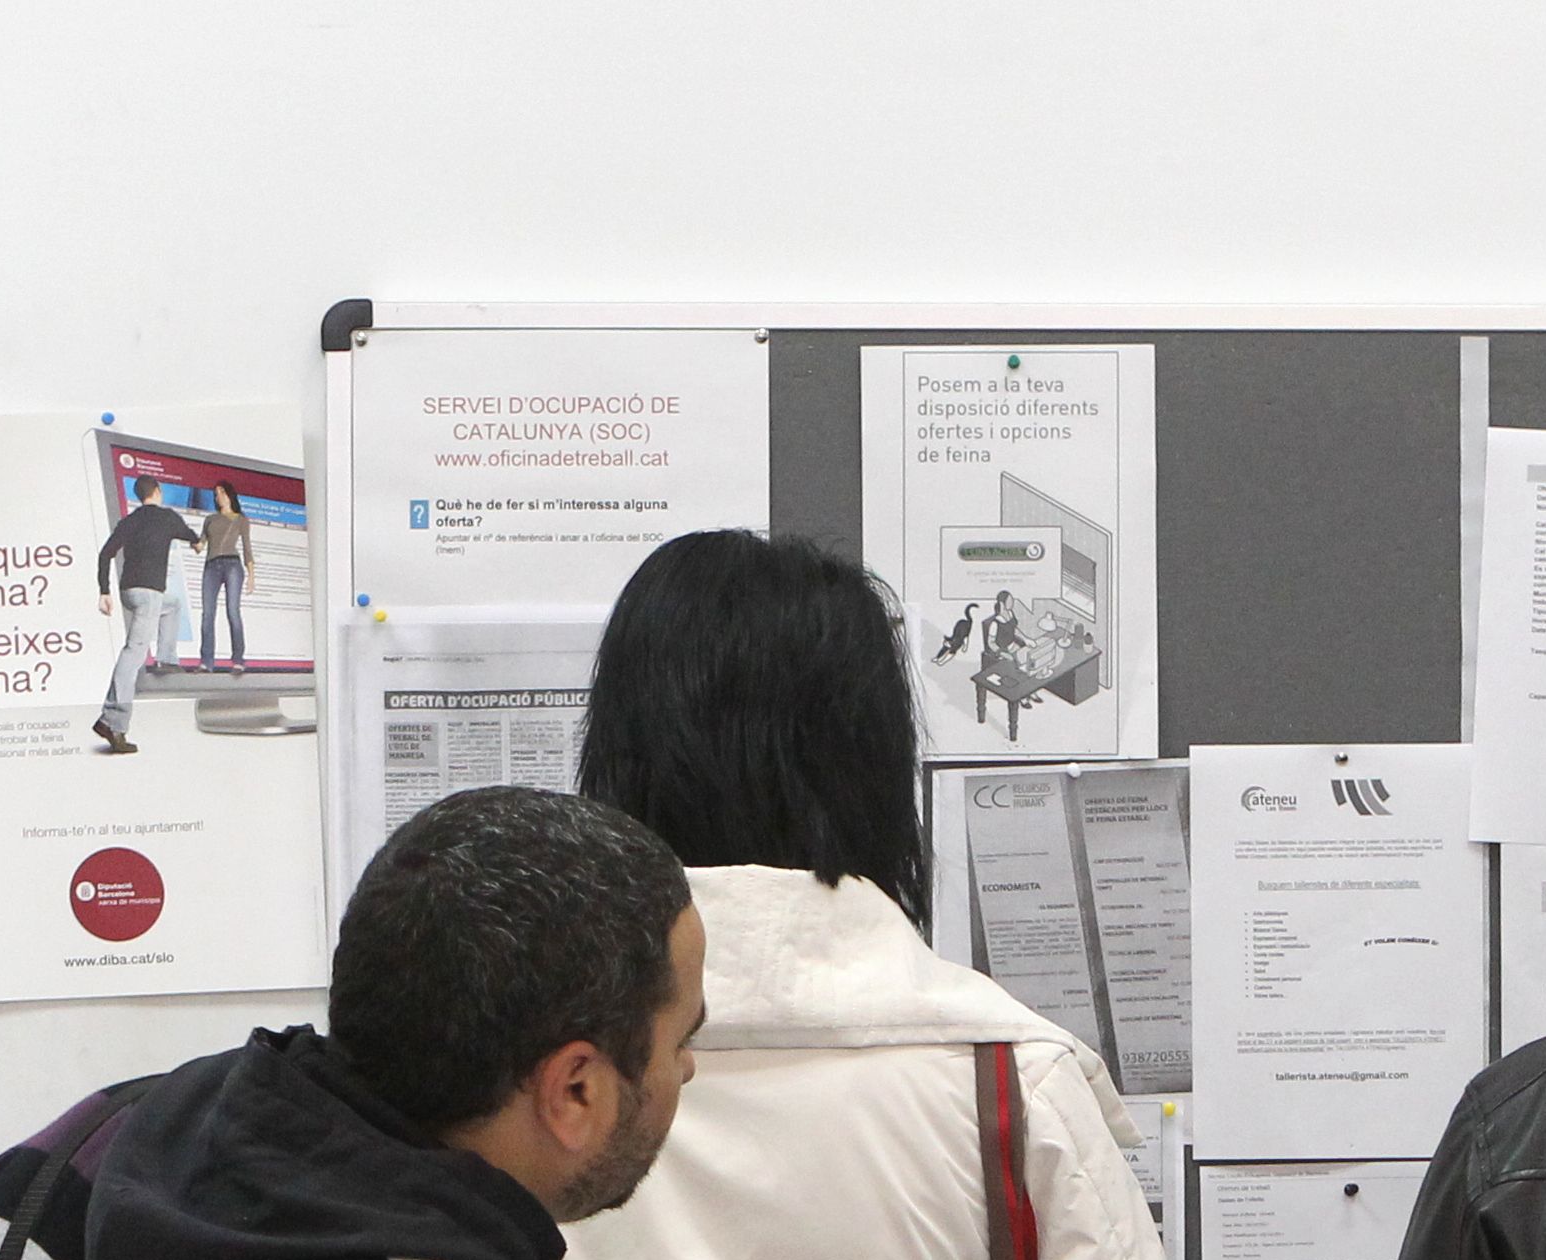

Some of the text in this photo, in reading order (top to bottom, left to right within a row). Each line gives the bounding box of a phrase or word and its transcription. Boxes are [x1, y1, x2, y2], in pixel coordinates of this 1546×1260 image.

[918, 376, 1063, 392] Posem a la teva
[424, 393, 679, 414] SERVEI D'OCUPACIÓ DE
[918, 399, 1098, 419] disposició diferents
[454, 423, 650, 444] CATALUNYA (SOC)
[918, 423, 1071, 443] ofertes i opcions
[435, 450, 668, 466] www.oficinadetreball.cat
[918, 446, 990, 462] de feina
[436, 499, 667, 512] Què he de fer si m'interessa alguna
[436, 516, 482, 527] oferta?
[390, 695, 445, 708] OFERTA
[448, 692, 532, 707] D'OCUPACIÓ
[17, 719, 70, 732] d'ocupació
[1252, 796, 1297, 805] ateneu
[23, 820, 203, 838] Informa-te'n al teu ajuntament!
[982, 882, 1041, 893] ECONOMISTA
[64, 952, 175, 968] www.diba.cat/slo
[1122, 1050, 1190, 1065] 938720555
[1276, 1072, 1408, 1081] tallerista.ateneu@gmail.com
